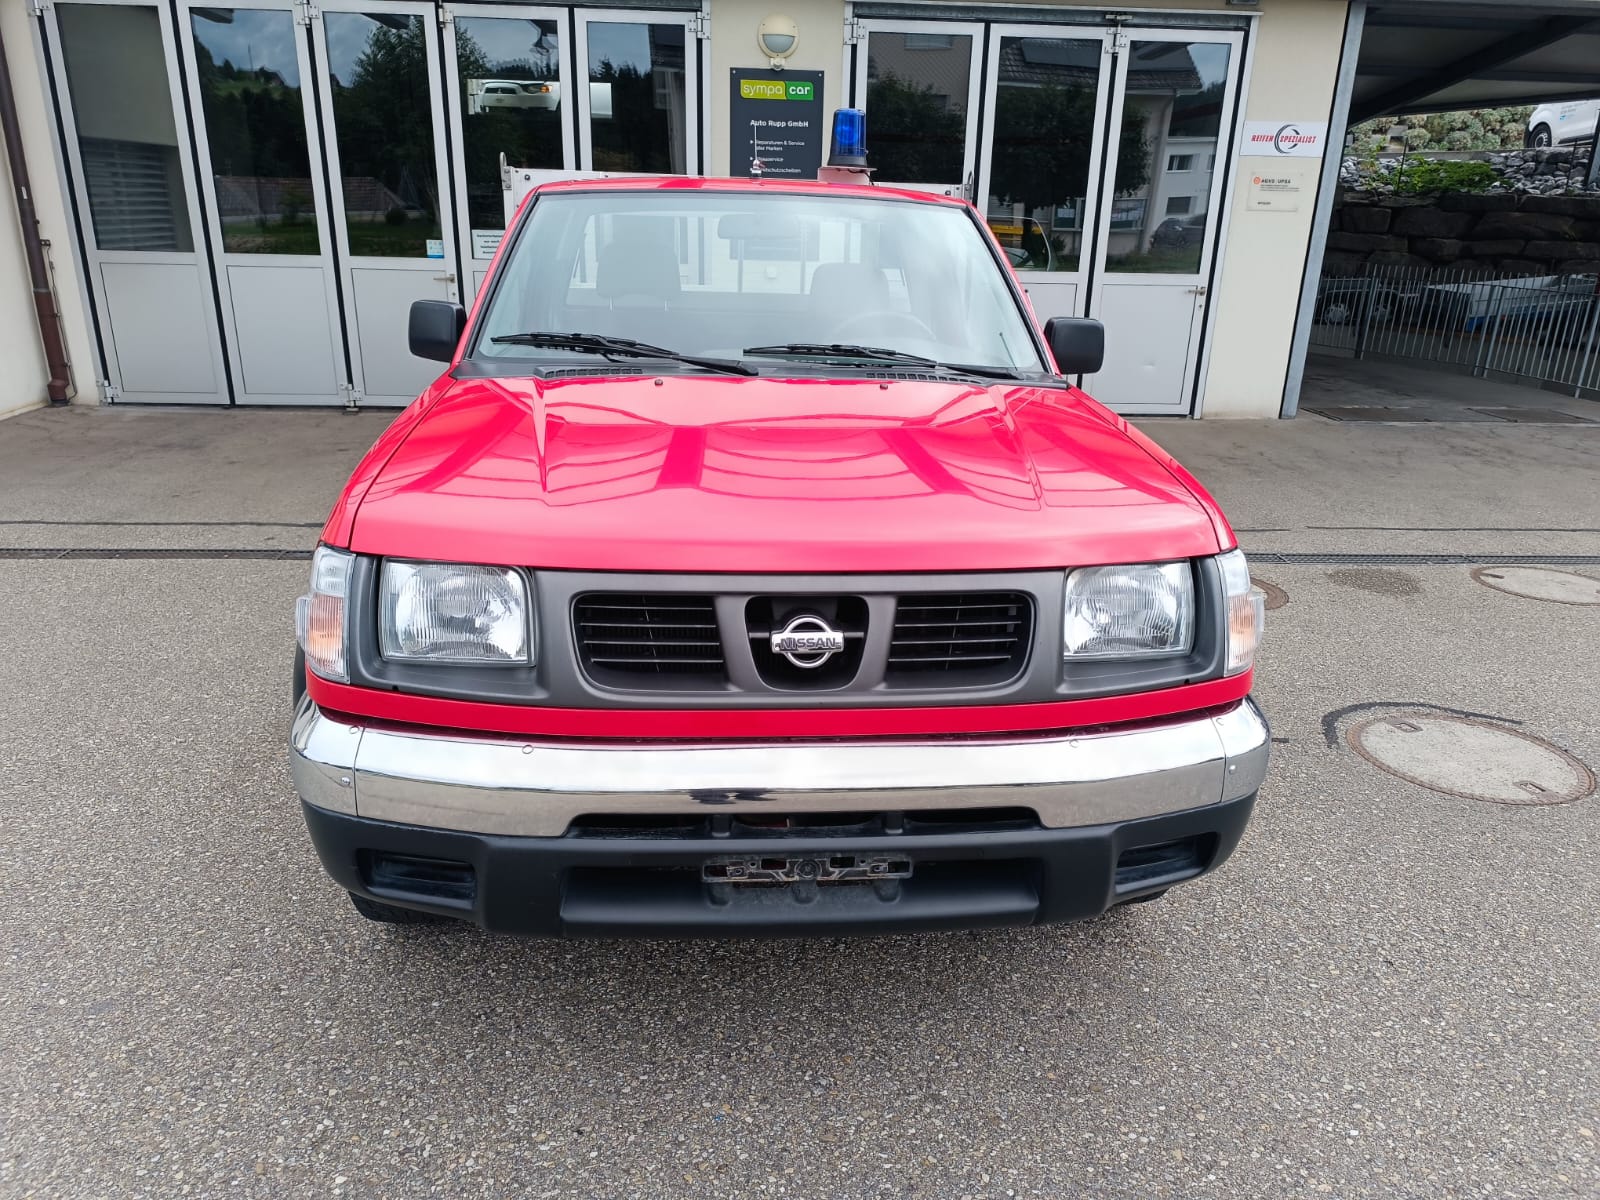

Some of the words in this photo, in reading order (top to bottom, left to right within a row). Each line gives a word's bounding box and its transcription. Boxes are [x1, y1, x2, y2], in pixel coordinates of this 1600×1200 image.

[743, 84, 783, 97] sympa
[789, 86, 811, 95] car
[768, 120, 786, 128] Rupp
[1251, 134, 1274, 143] REIFEN
[1280, 135, 1316, 143] SPEZIALIST
[780, 636, 836, 650] NISSAN
